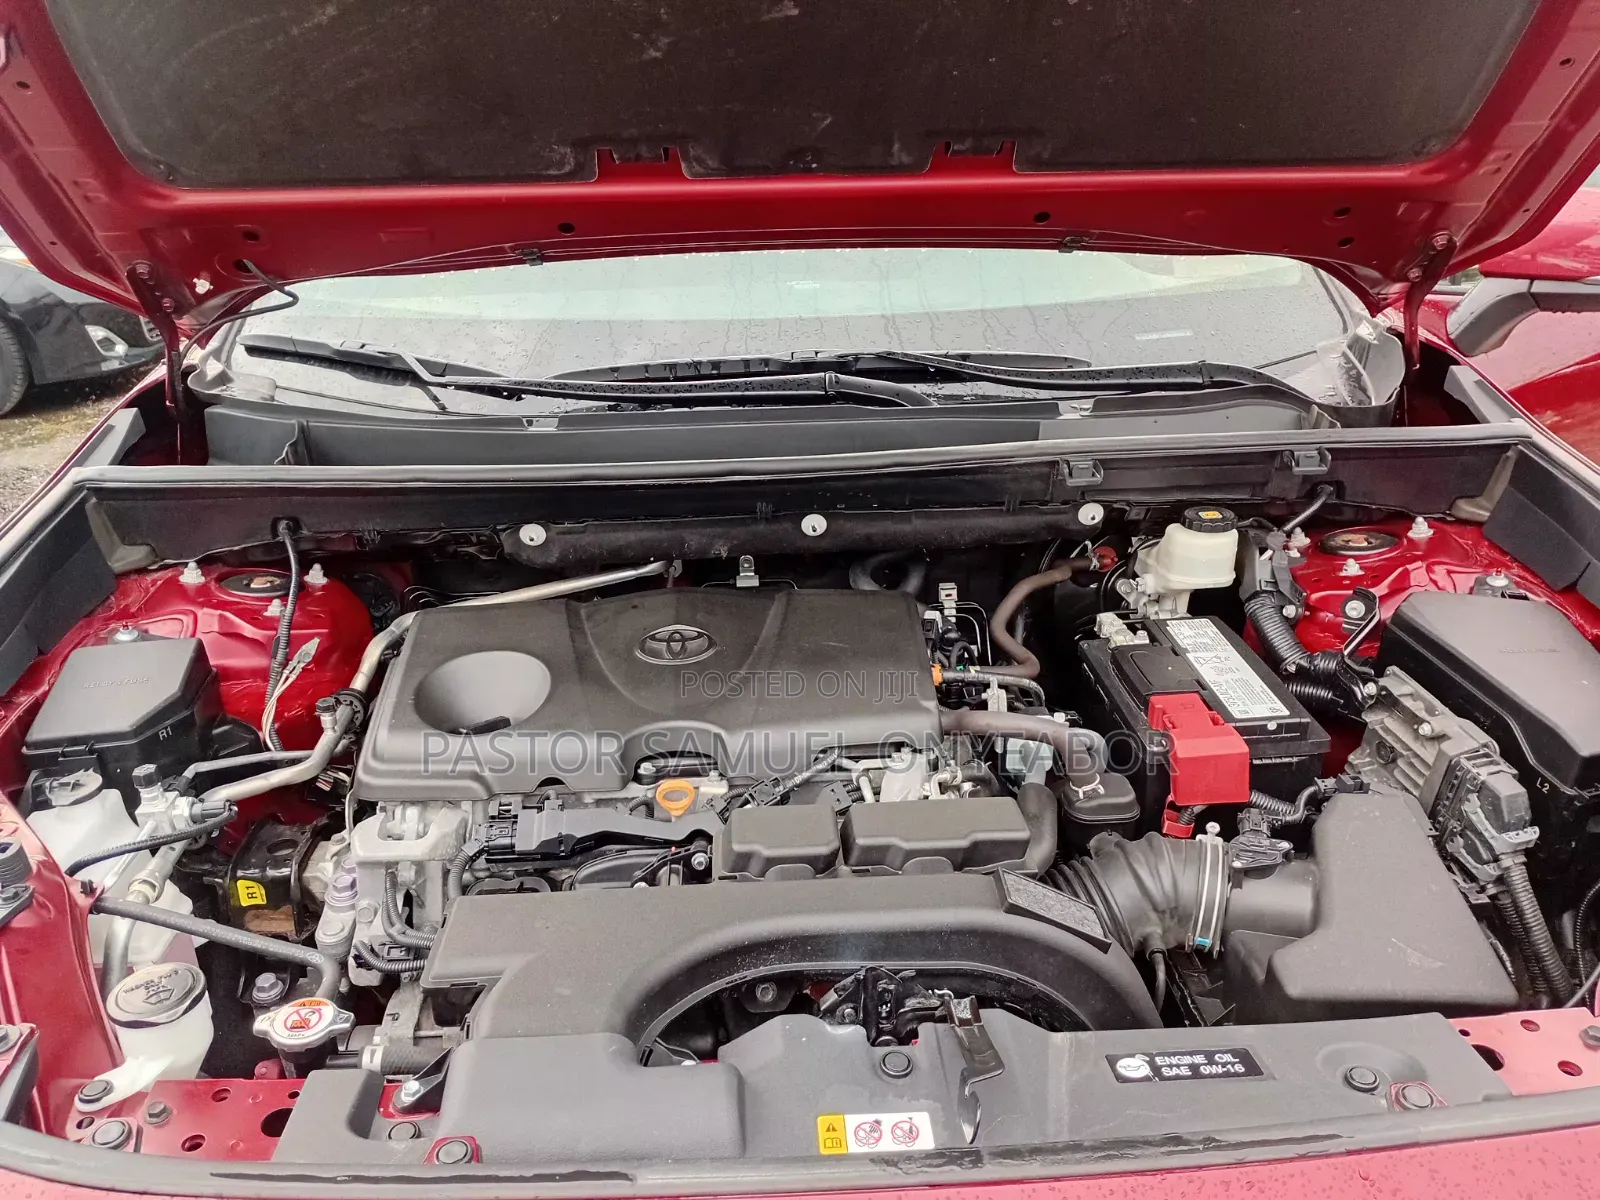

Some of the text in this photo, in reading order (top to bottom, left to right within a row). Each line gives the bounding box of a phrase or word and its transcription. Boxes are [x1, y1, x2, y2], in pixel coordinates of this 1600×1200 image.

[158, 726, 173, 741] R1
[1536, 777, 1550, 794] L2
[245, 886, 258, 900] R1
[1154, 1053, 1240, 1066] ENGINE OIL
[1161, 1063, 1245, 1077] SAE 0W-16
